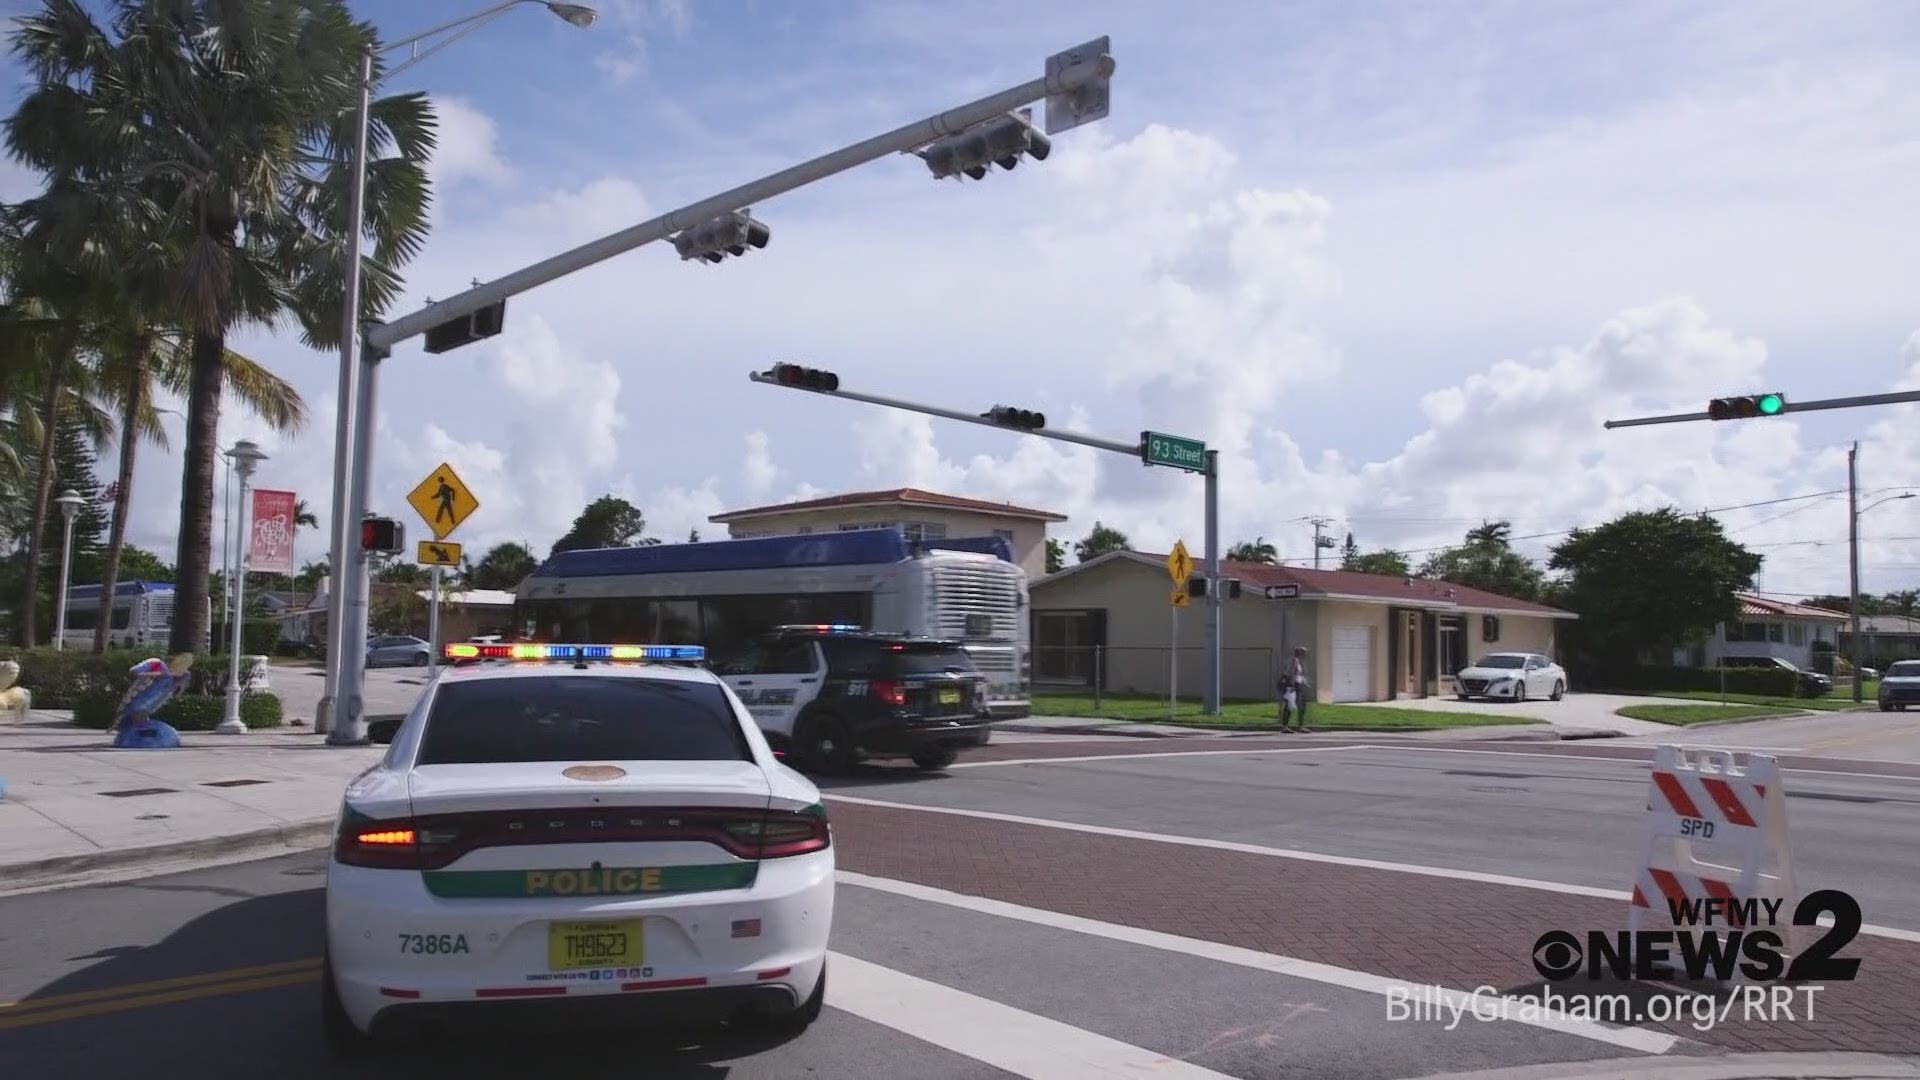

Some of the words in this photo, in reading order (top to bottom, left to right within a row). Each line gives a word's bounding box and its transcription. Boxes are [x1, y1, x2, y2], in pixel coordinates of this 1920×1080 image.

[1152, 440, 1169, 458] 93
[1173, 445, 1200, 463] Street
[847, 682, 868, 695] 911
[1680, 818, 1714, 838] SPD
[526, 867, 662, 896] POLICE
[399, 934, 469, 954] 7386A
[565, 933, 627, 958] TH9623
